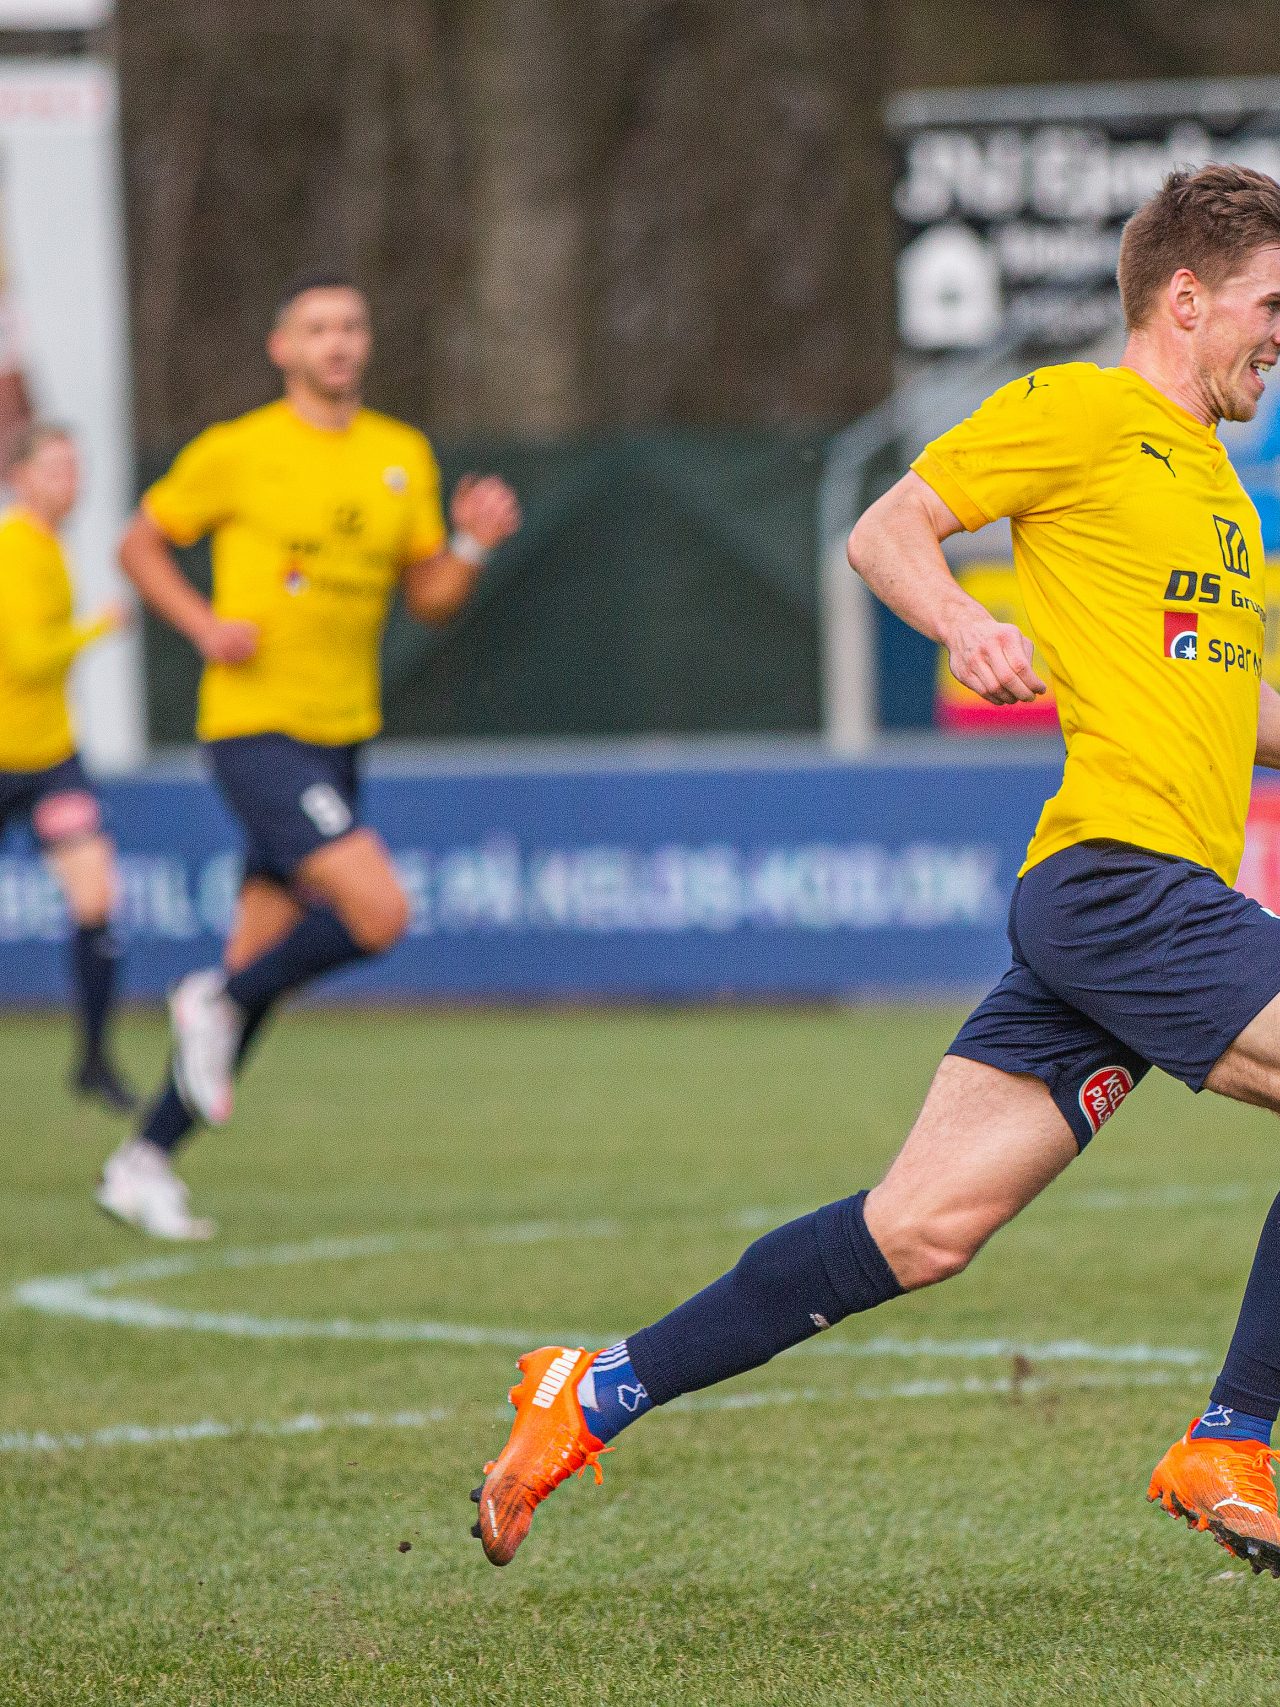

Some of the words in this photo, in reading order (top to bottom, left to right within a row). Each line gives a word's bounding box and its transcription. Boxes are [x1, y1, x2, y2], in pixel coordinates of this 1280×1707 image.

[1163, 569, 1221, 604] DS
[1208, 638, 1251, 672] spar
[532, 1349, 582, 1409] PUMA
